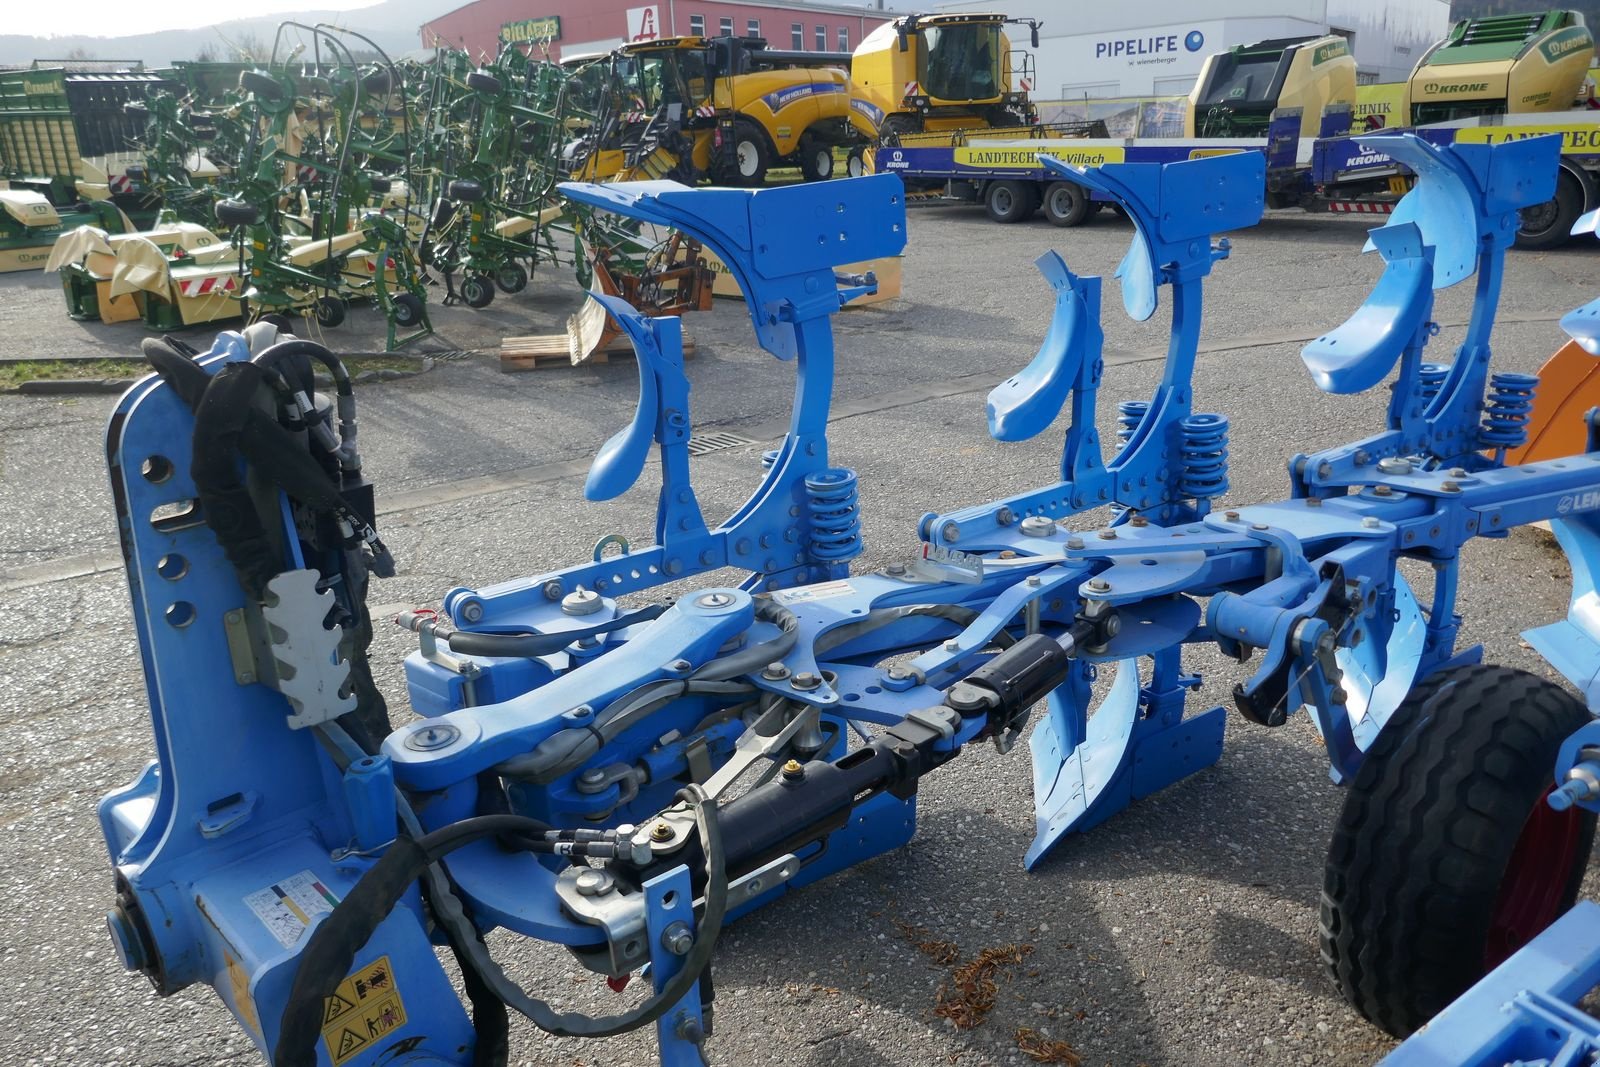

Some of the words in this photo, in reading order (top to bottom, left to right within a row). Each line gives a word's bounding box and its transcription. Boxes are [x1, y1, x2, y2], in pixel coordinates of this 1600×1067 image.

[1096, 35, 1178, 58] PIPELIFE
[1136, 56, 1177, 66] wienerberger
[1439, 82, 1489, 94] KRONE
[886, 161, 910, 169] KRONE
[1346, 153, 1391, 167] KRONE
